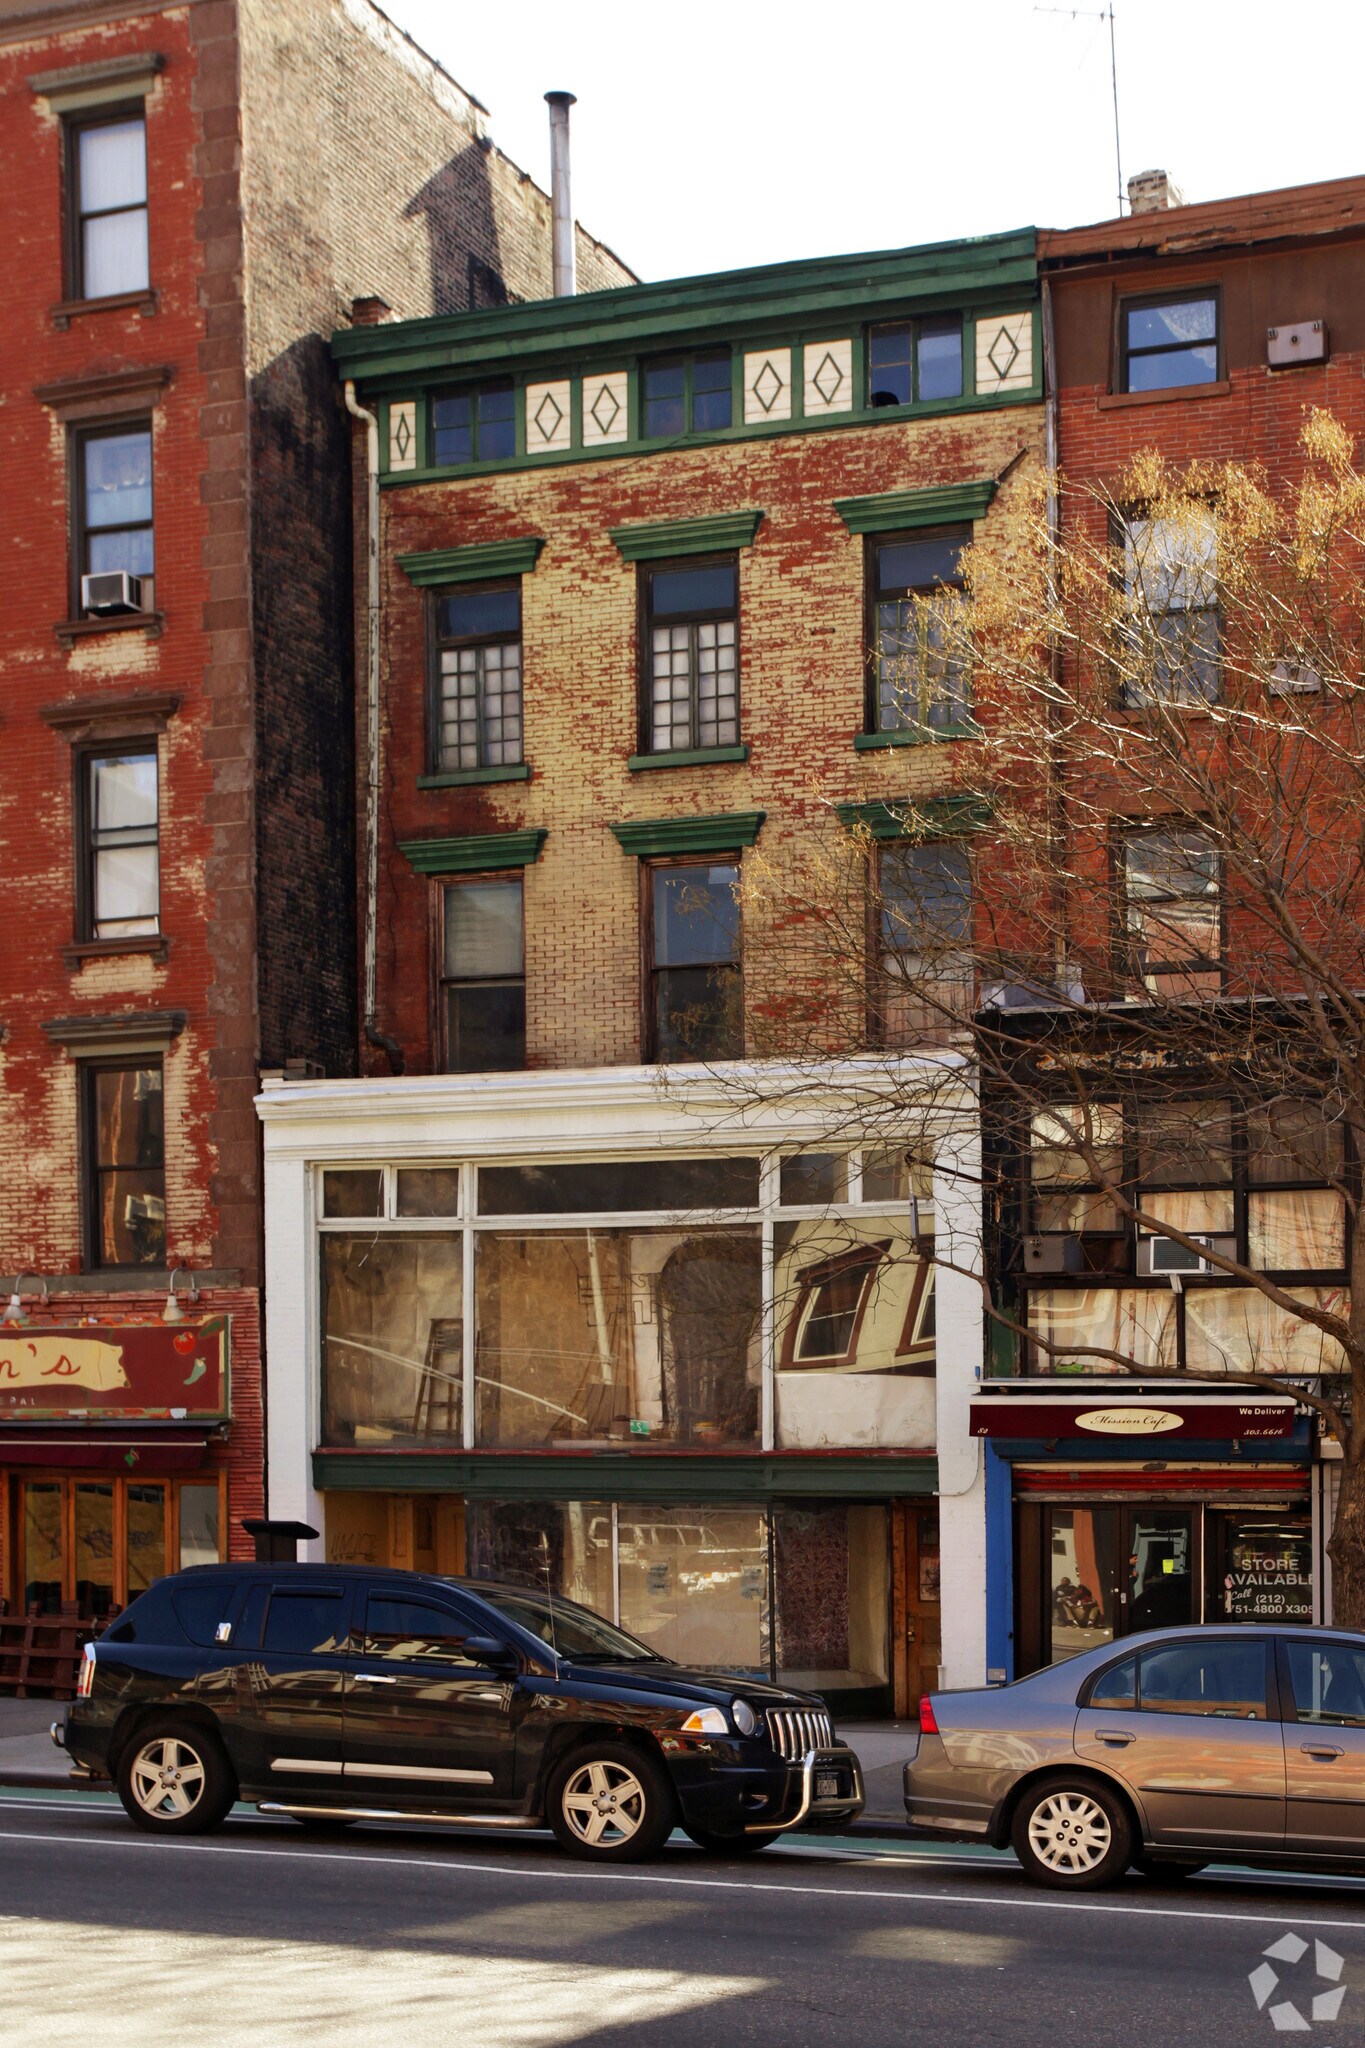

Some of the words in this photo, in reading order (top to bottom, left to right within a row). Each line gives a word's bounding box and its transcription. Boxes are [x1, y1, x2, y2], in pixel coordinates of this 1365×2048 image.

[1239, 1407, 1253, 1415] We
[1254, 1407, 1286, 1415] Deliver
[1090, 1415, 1140, 1425] Mission
[1143, 1414, 1168, 1431] Cafe
[1241, 1559, 1299, 1571] STORE
[1231, 1588, 1252, 1600] Call
[1255, 1594, 1286, 1605] (212)
[1230, 1604, 1283, 1614] 51-4800
